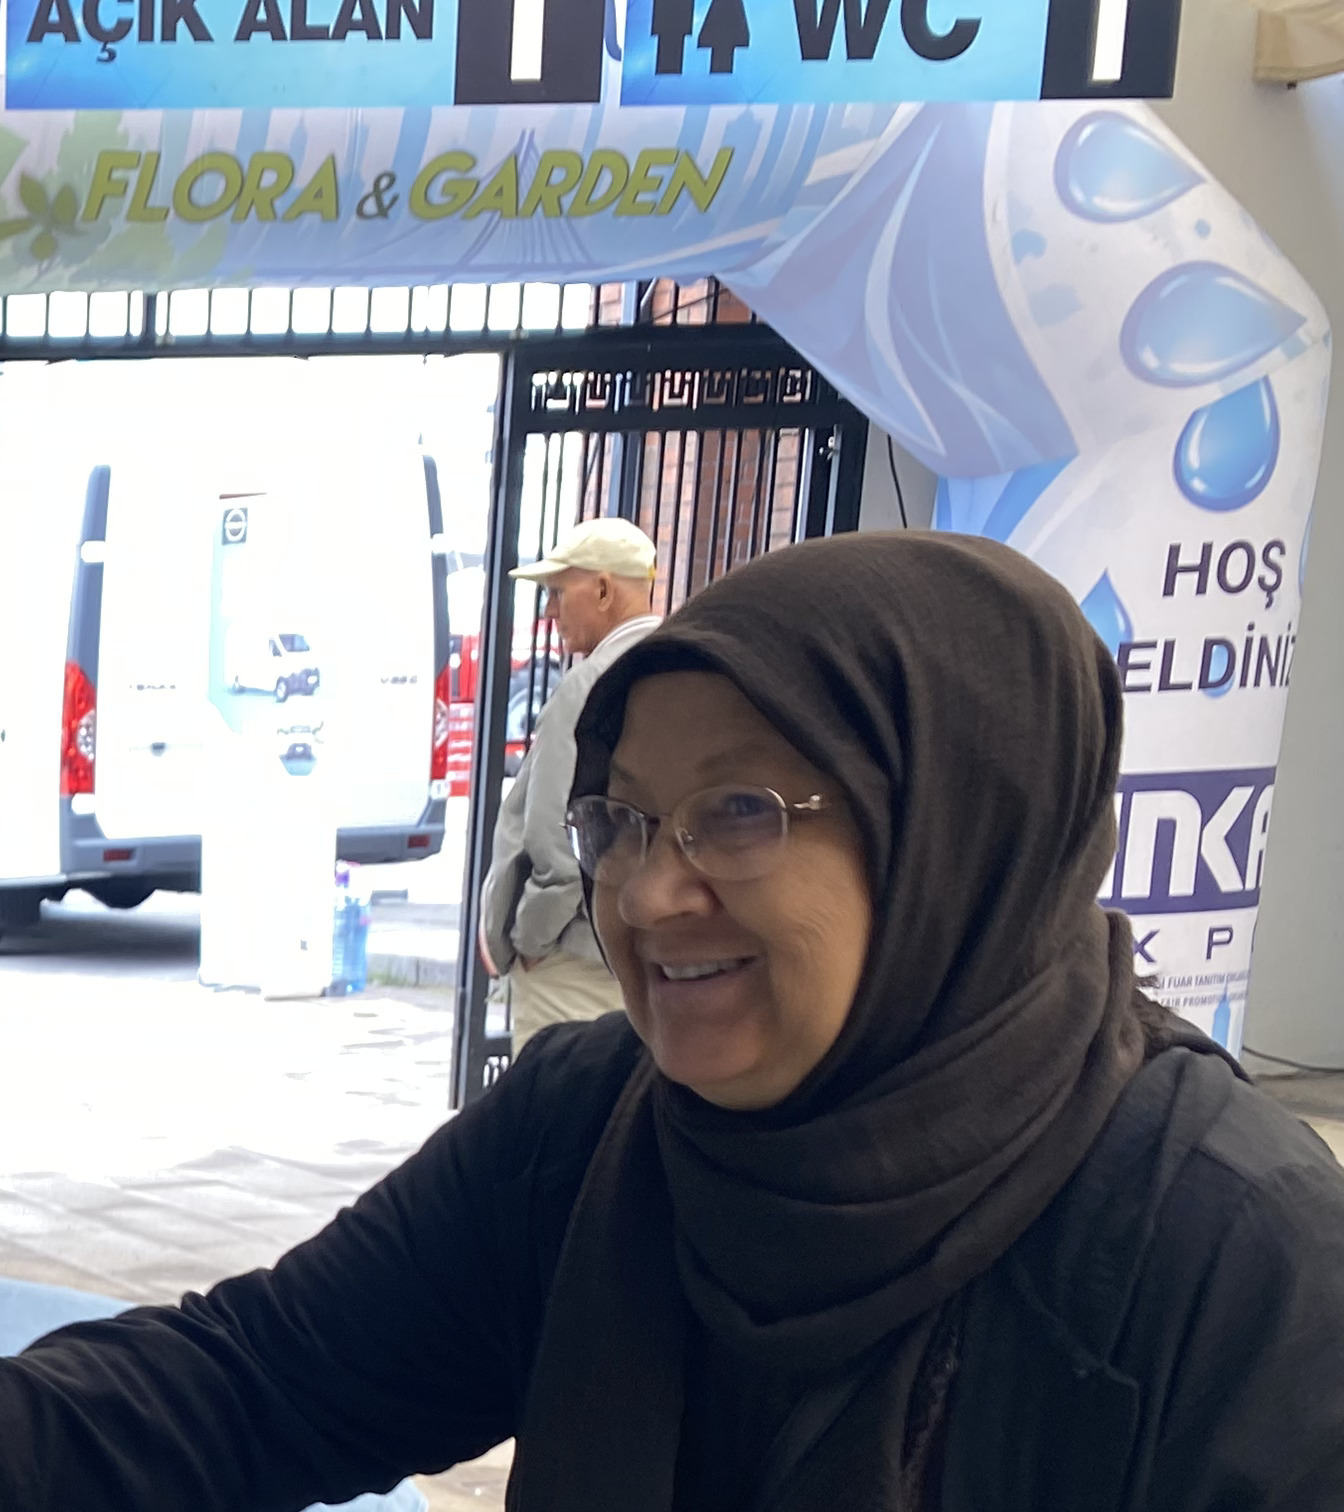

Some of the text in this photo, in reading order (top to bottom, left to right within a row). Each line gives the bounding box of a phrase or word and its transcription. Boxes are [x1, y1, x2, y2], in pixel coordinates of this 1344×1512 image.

[78, 146, 735, 224] FLORA & GARDEN
[1161, 537, 1286, 608] HOŞ
[1116, 621, 1296, 692] ELDİNİ
